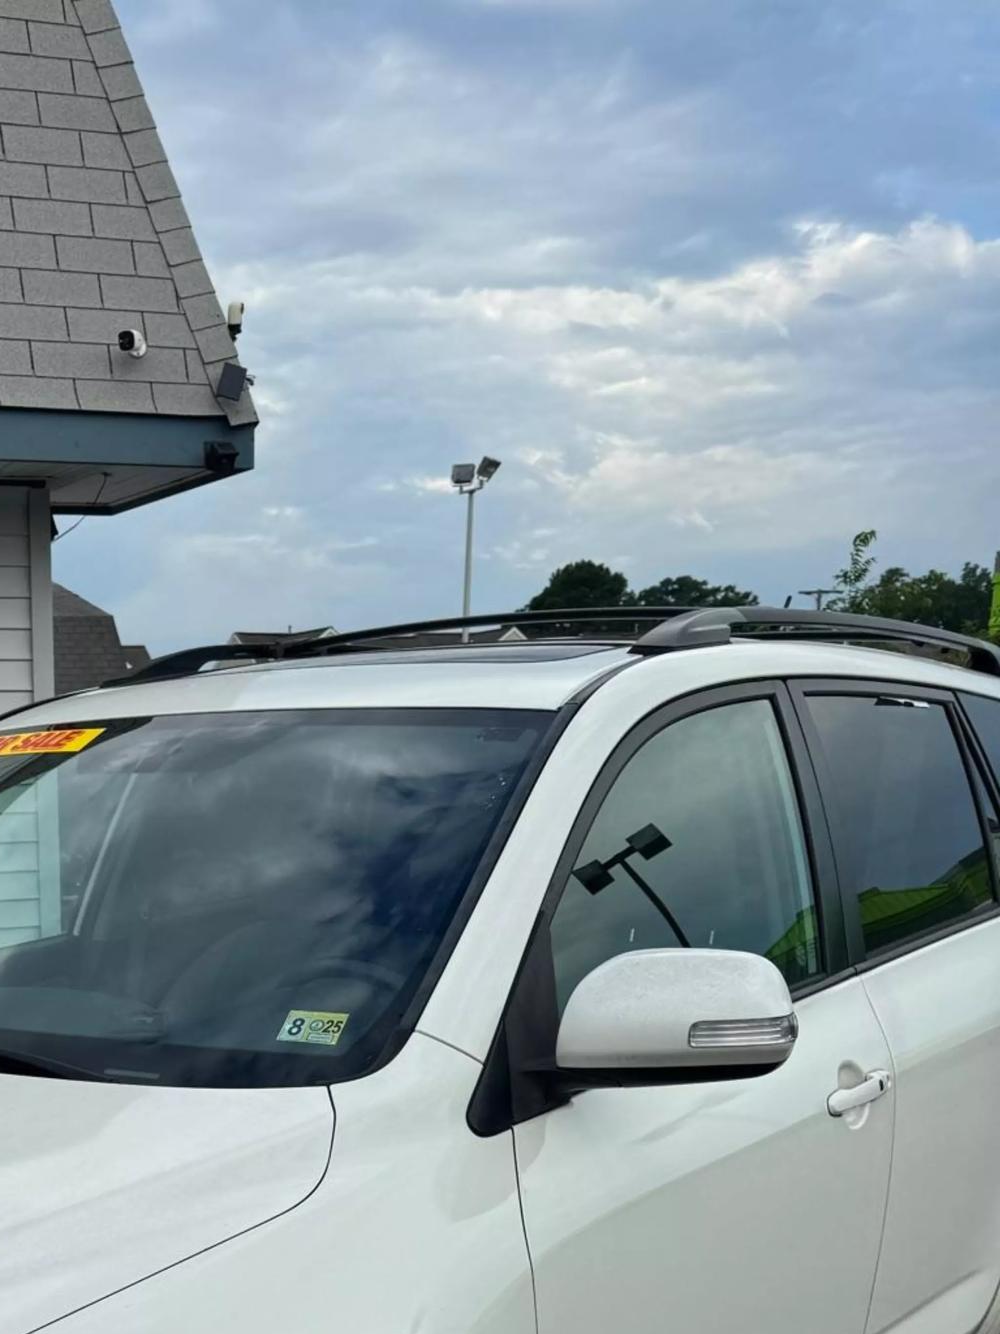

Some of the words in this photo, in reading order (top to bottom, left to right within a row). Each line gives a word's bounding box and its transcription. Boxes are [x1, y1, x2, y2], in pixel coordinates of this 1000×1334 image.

[13, 730, 86, 751] SALE
[288, 1018, 305, 1036] 8
[321, 1019, 343, 1034] 25
